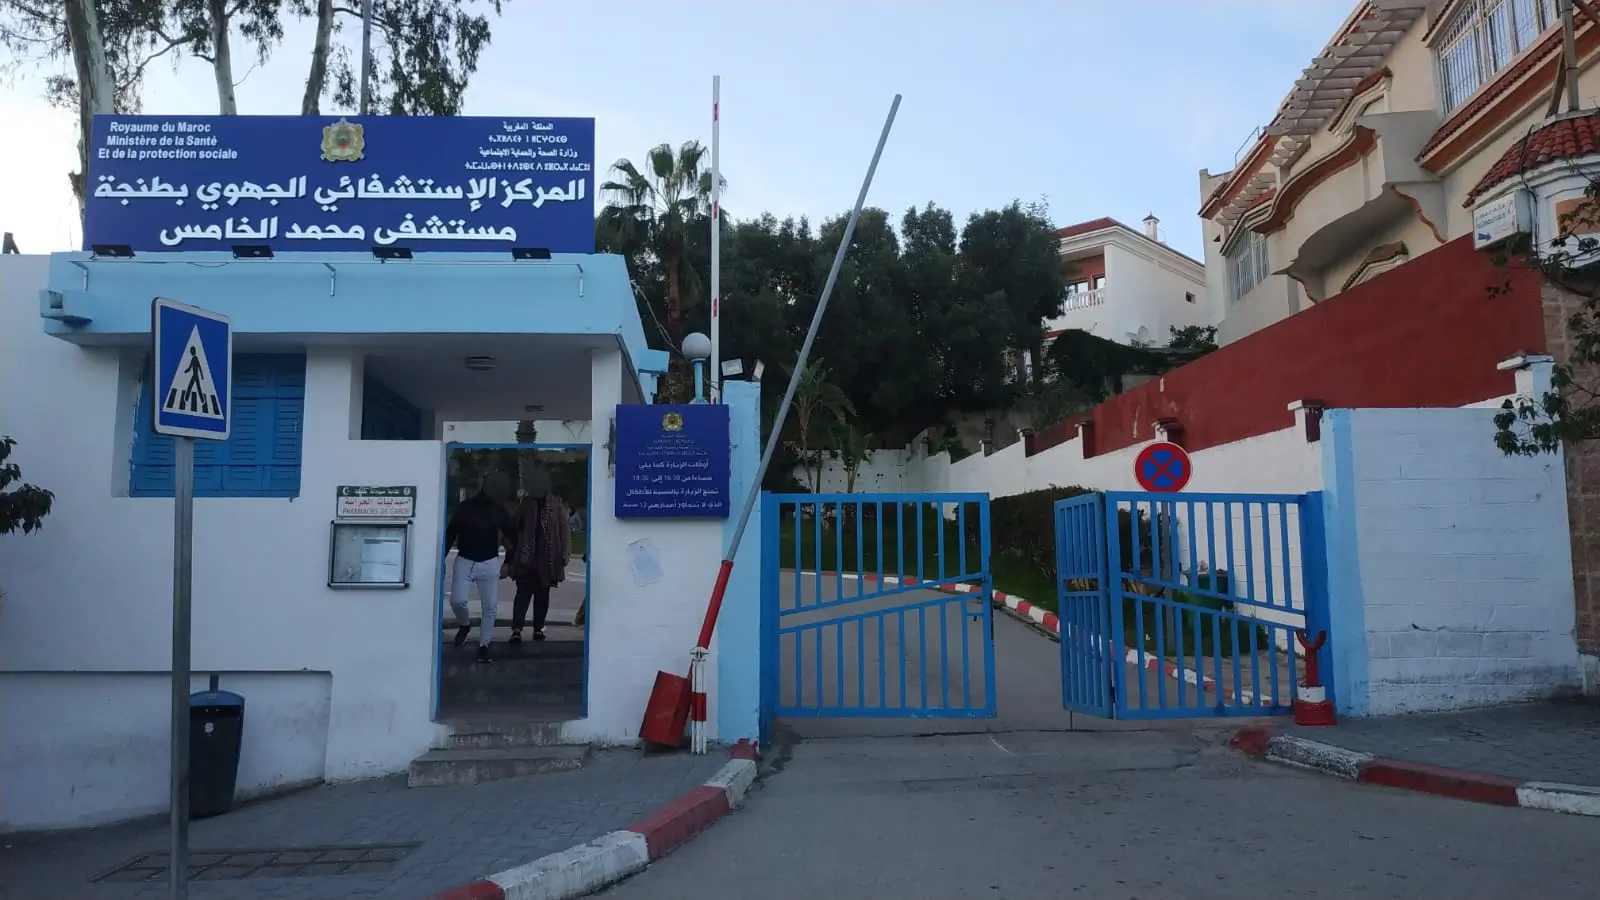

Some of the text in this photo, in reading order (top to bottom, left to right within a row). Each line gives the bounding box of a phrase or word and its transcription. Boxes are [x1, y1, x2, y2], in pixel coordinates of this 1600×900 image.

[110, 122, 211, 134] Royaume du Maroc
[503, 121, 554, 132] المملكة المغربية
[107, 135, 217, 146] Ministère de la Santé
[98, 148, 238, 160] Et de la protection sociale
[479, 146, 578, 158] وزارة الصحة والحماية الاجتماعية
[94, 173, 585, 212] المركز الإستشفائي الجهوي بطنجة
[159, 212, 517, 246] مستشفى محمد الخامس
[666, 460, 687, 470] الزيارة
[687, 459, 709, 469] أوقات
[680, 487, 702, 496] الزيارة
